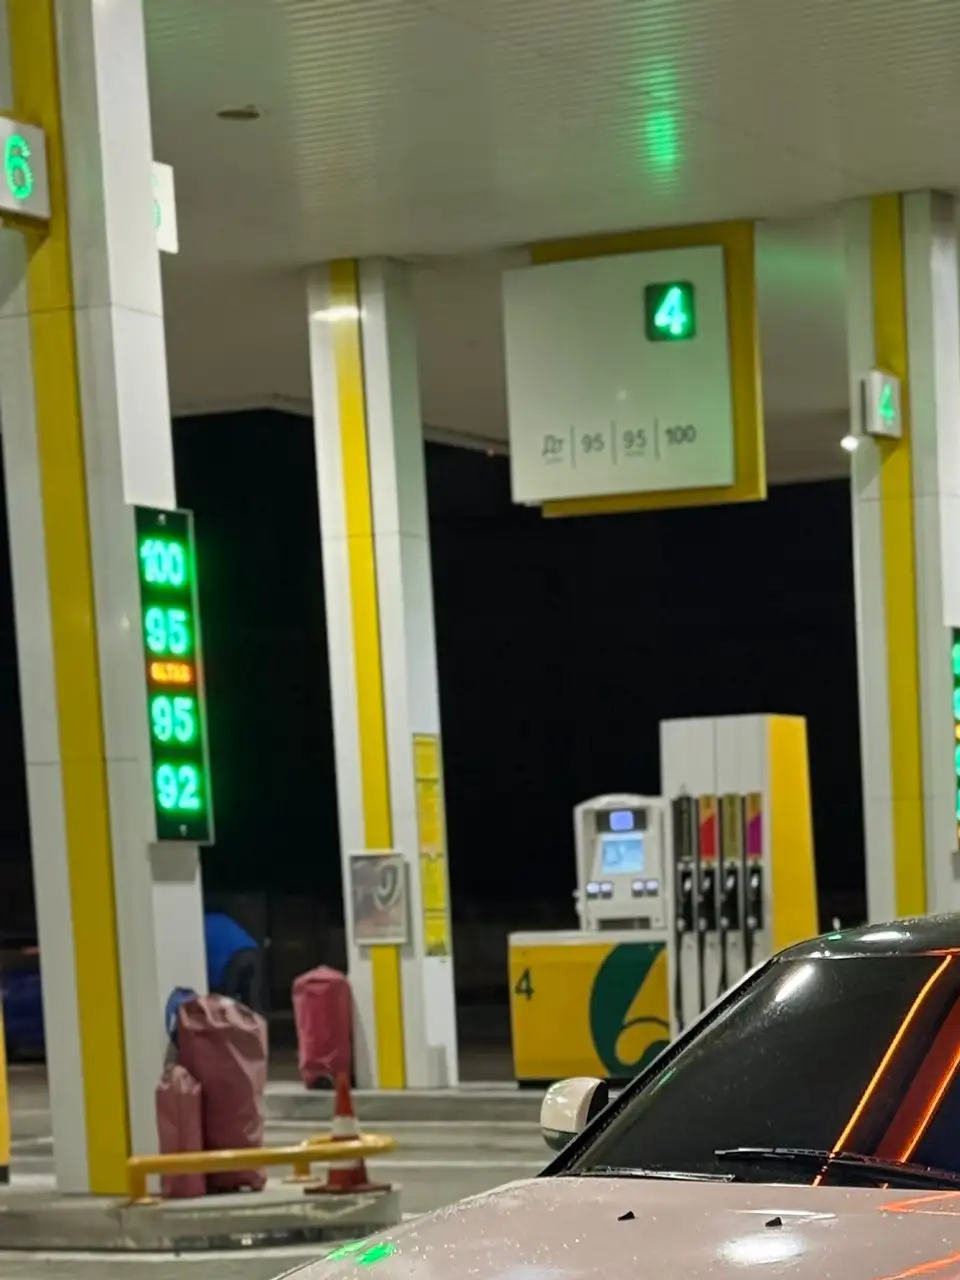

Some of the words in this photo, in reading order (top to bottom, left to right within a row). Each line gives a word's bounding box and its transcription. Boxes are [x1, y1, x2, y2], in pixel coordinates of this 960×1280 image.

[4, 132, 34, 200] 6
[654, 286, 688, 335] 4
[581, 432, 605, 453] 95
[623, 428, 647, 449] 95
[664, 424, 697, 445] 100
[140, 539, 185, 586] 100
[145, 607, 188, 655] 95
[151, 695, 194, 742] 95
[156, 763, 200, 810] 92
[515, 968, 535, 1002] 4
